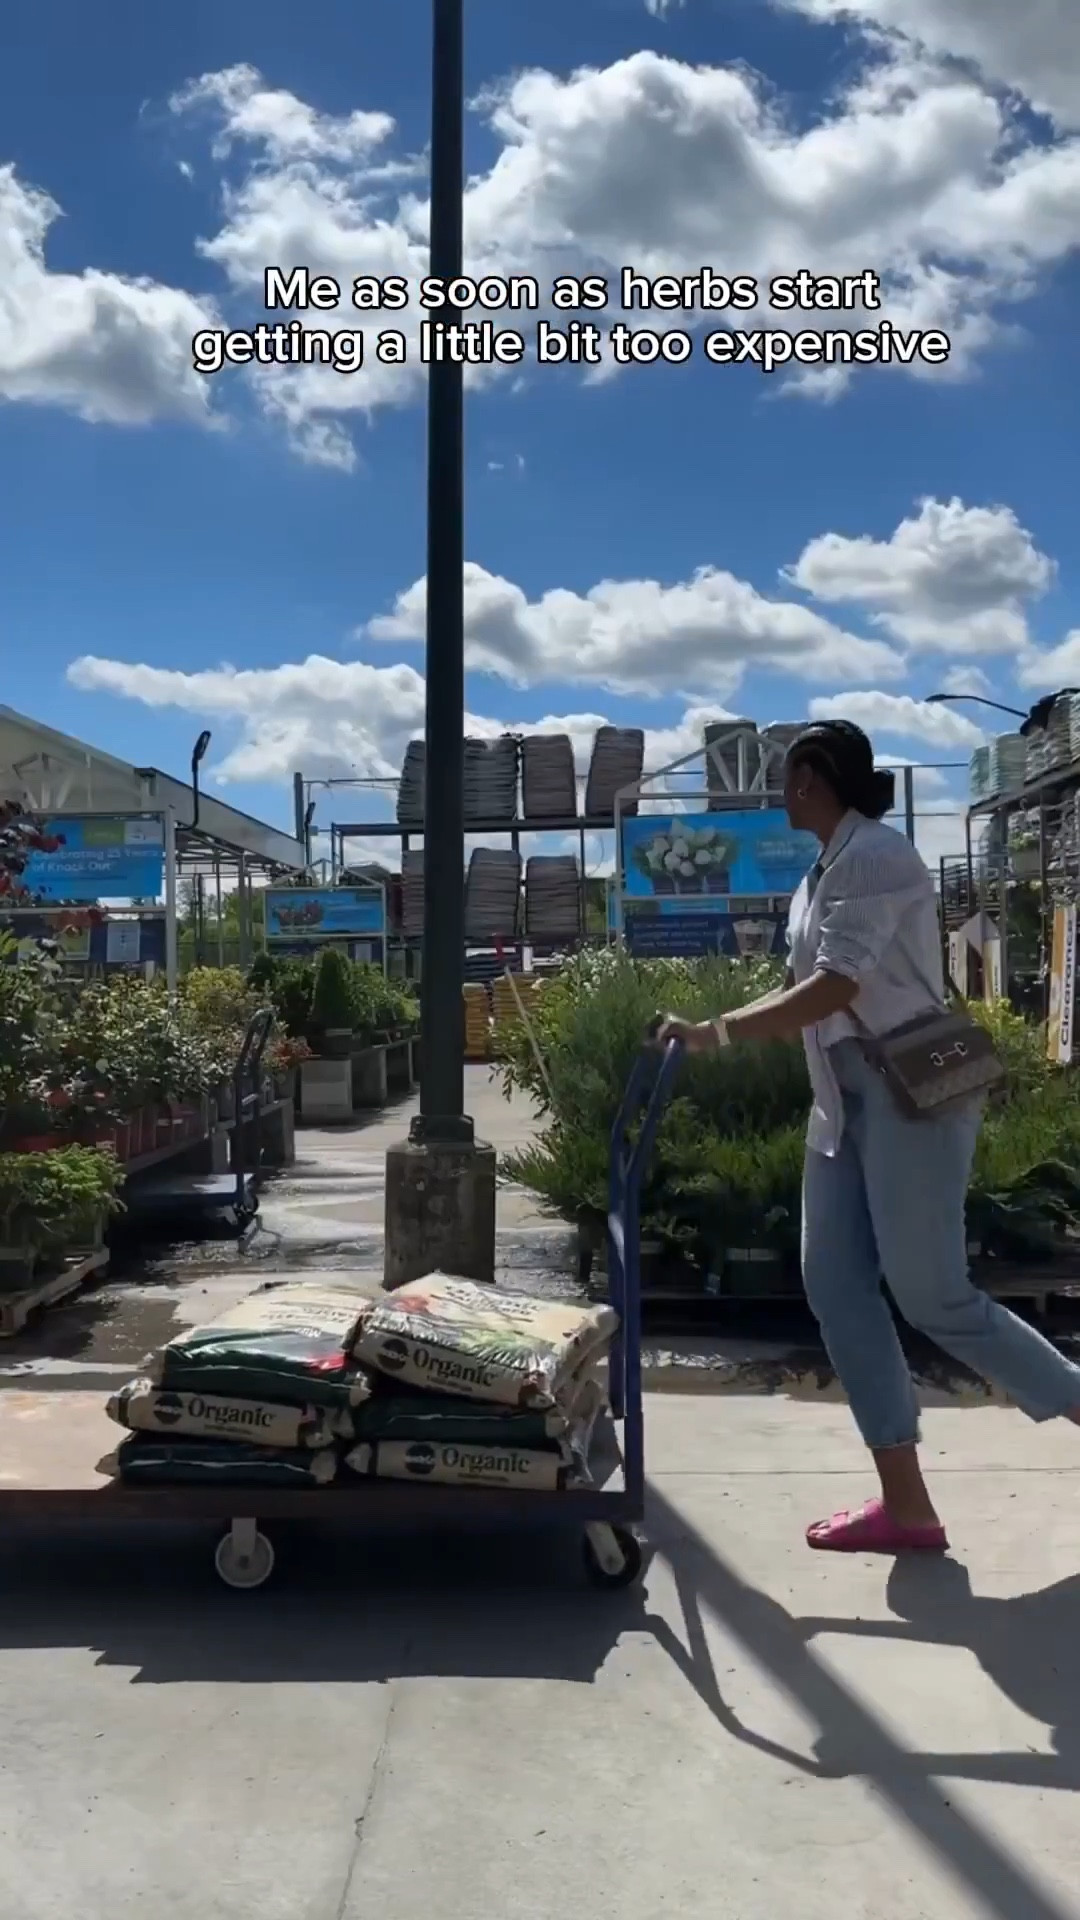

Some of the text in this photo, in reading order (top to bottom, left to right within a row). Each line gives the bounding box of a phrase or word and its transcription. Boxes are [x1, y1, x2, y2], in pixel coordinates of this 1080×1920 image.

[32, 861, 45, 872] of
[47, 861, 85, 872] Knock
[1061, 919, 1074, 1046] Clearance
[412, 1347, 494, 1388] Organic
[187, 1398, 273, 1429] Organic
[441, 1447, 531, 1475] Organic
